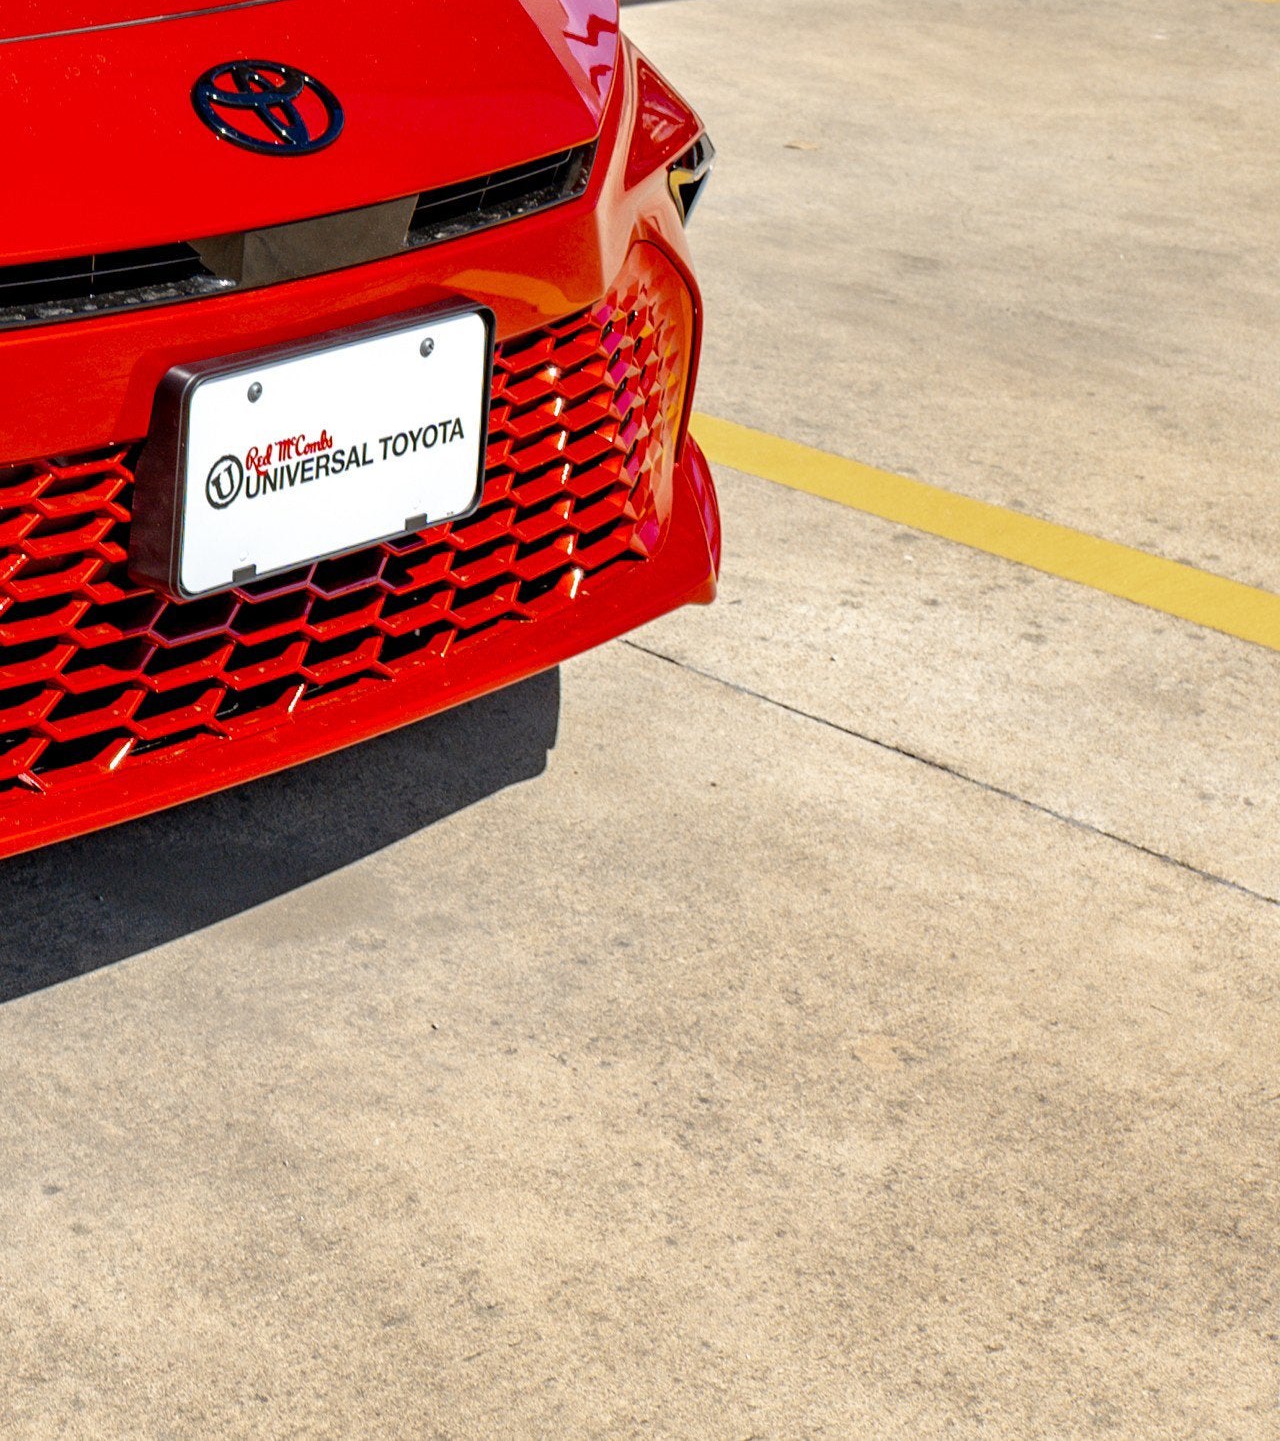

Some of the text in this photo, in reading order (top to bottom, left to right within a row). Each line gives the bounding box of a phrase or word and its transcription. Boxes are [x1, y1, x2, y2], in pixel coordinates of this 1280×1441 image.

[245, 429, 333, 476] Red McCombs
[245, 417, 464, 499] UNIVERSAL TOYOTA
